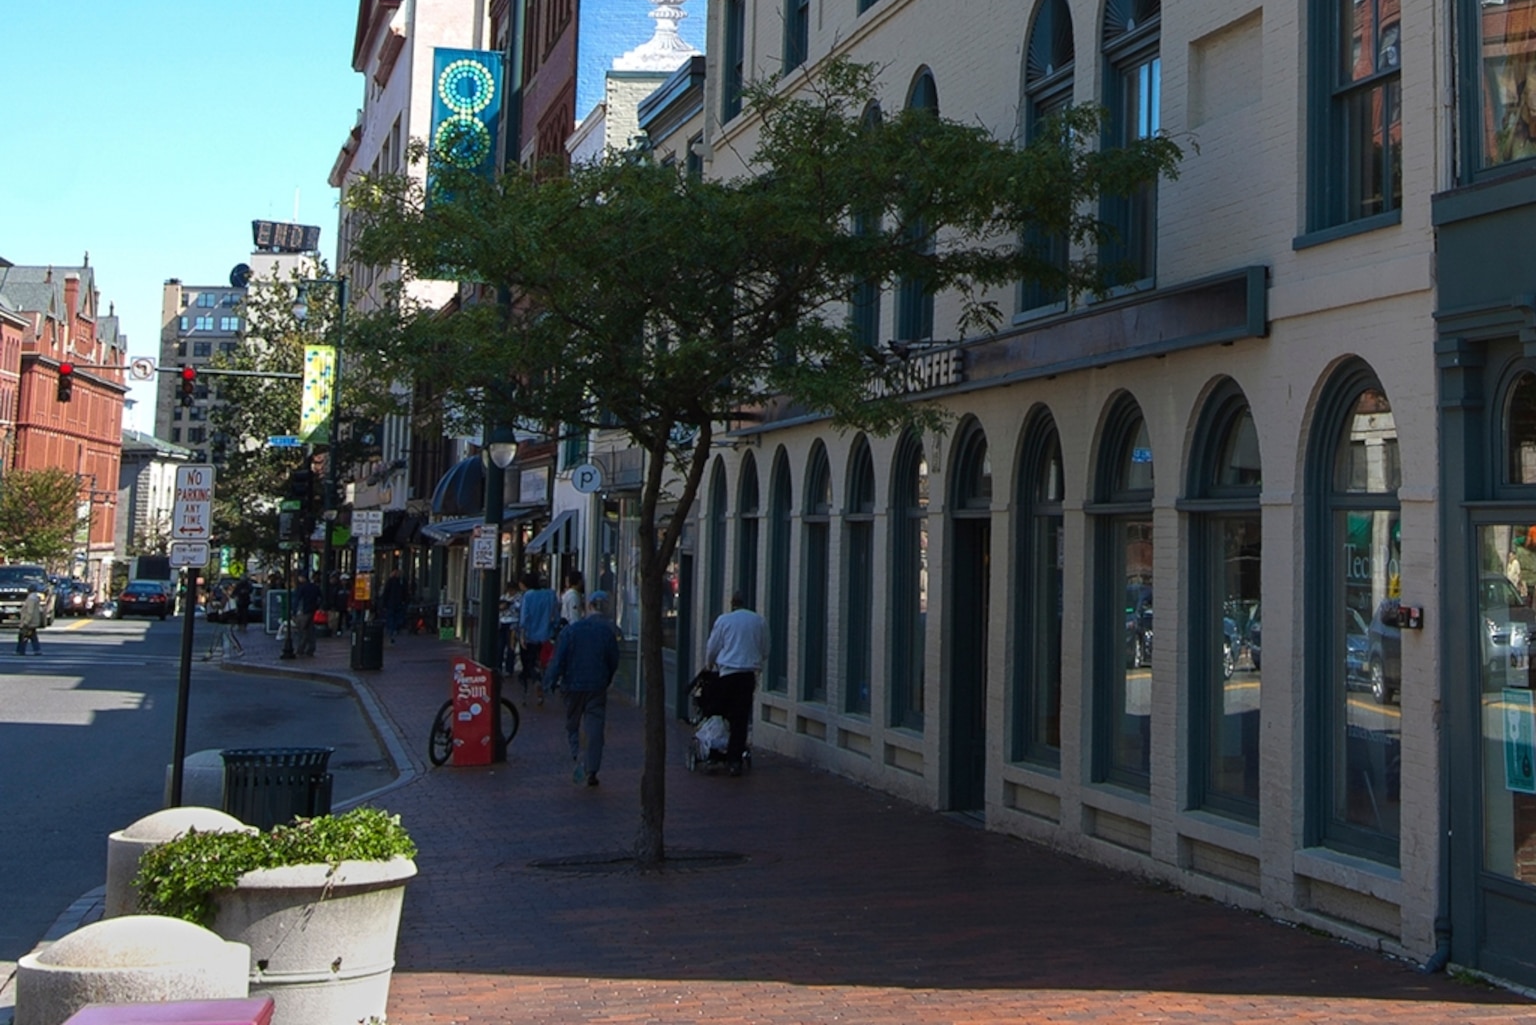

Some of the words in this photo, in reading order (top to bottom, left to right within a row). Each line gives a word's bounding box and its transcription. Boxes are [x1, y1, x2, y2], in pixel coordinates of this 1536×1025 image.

[187, 471, 203, 486] NO
[177, 487, 211, 502] PARKING
[185, 503, 201, 513] ANY
[183, 514, 202, 525] TIME
[457, 684, 487, 699] Sun
